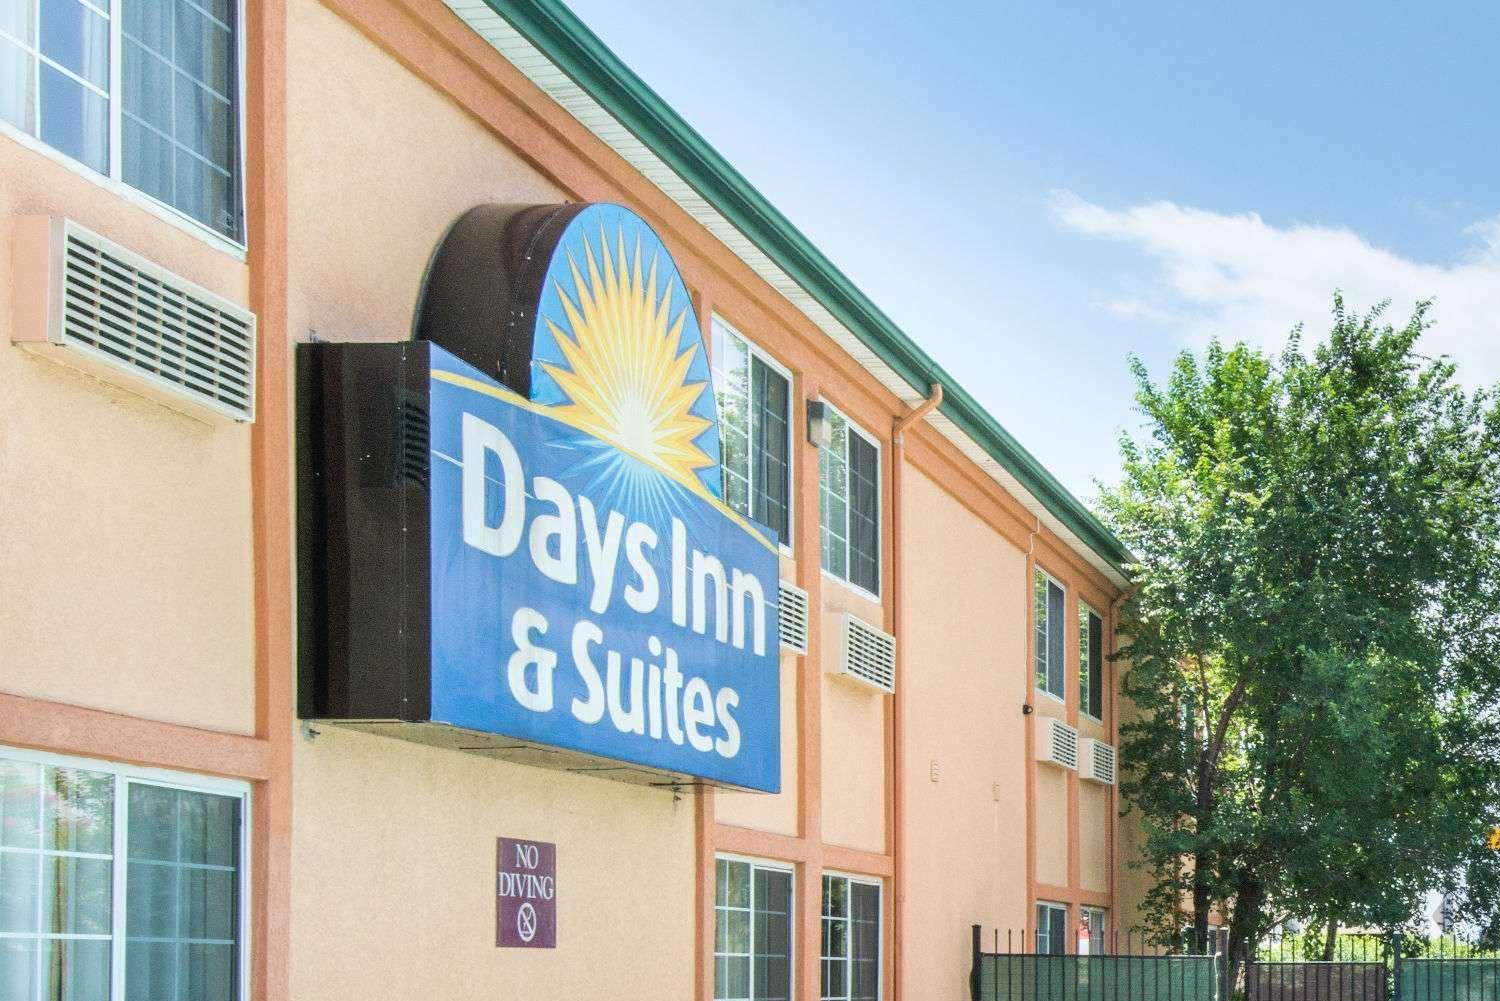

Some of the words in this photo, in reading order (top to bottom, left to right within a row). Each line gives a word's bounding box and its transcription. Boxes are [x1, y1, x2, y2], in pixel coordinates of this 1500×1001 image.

[462, 411, 660, 614] Days
[671, 517, 766, 657] Inn
[507, 607, 558, 713] &
[570, 619, 742, 759] Suites
[498, 872, 554, 900] DIVING
[513, 844, 539, 869] NO
